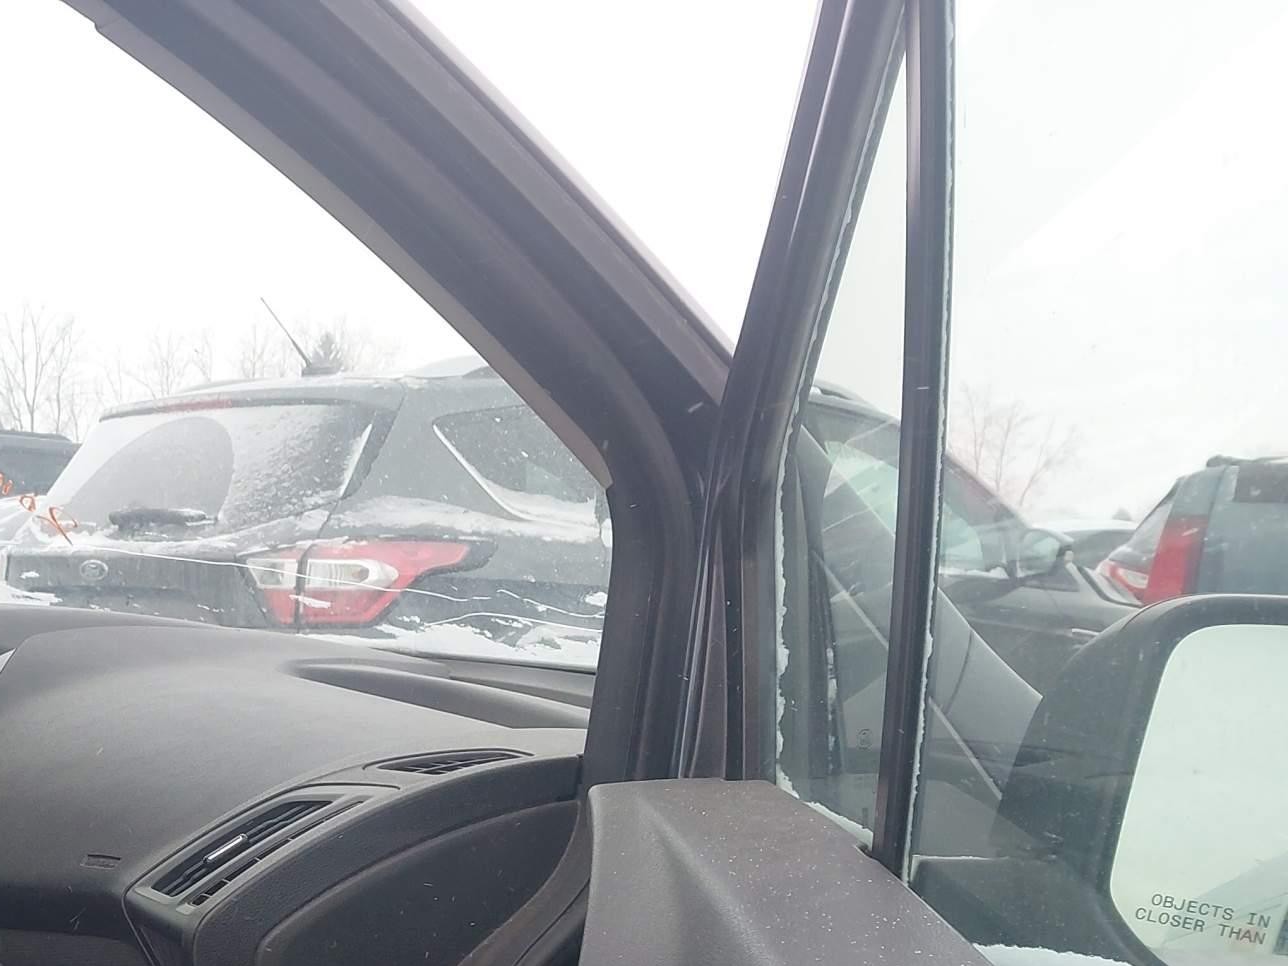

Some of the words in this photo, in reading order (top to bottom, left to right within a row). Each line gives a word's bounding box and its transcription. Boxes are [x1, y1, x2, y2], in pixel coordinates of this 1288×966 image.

[1135, 907, 1206, 933] CLOSER
[1218, 923, 1267, 945] THAN
[1151, 893, 1235, 921] OBJECTS
[1247, 912, 1271, 929] IN
